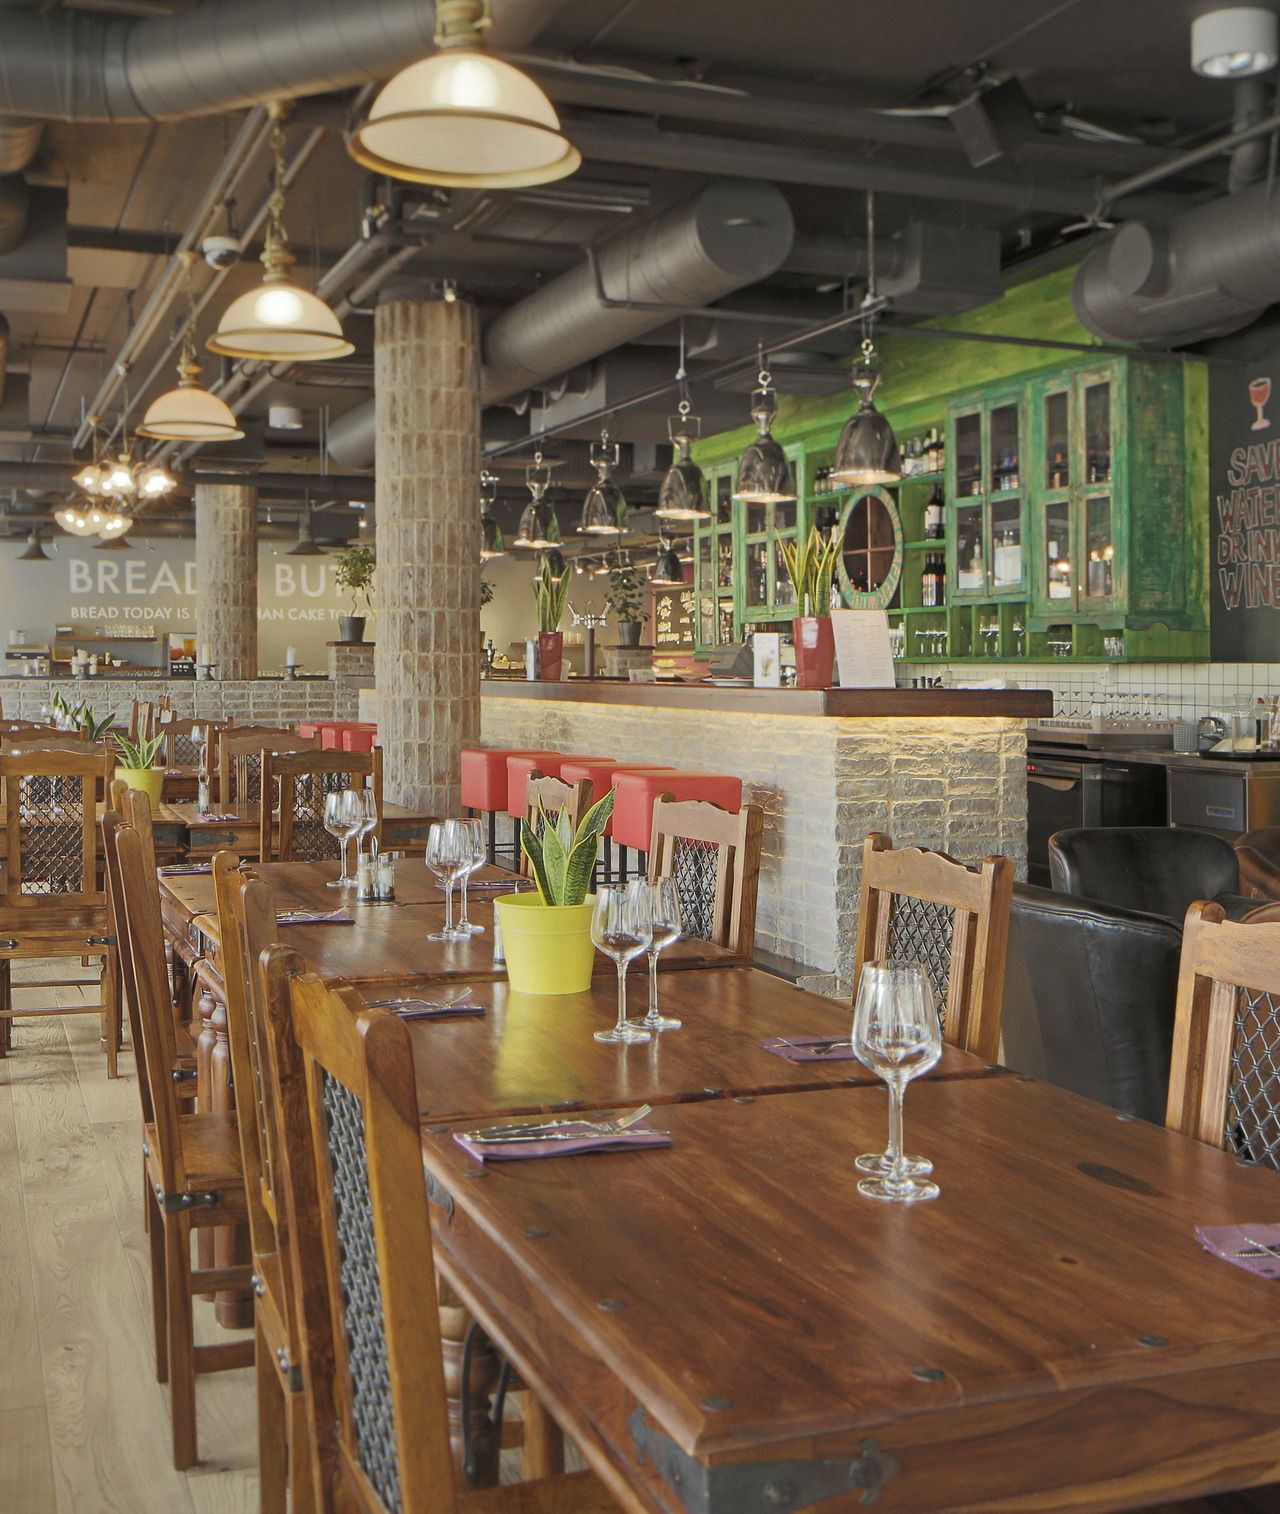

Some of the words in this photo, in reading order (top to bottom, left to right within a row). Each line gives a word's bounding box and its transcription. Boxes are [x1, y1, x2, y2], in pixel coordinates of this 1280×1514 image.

[275, 563, 352, 598] BUT
[71, 607, 119, 619] BREAD
[123, 607, 173, 620] TODAY
[177, 607, 190, 619] IS
[288, 608, 325, 621] CAKE
